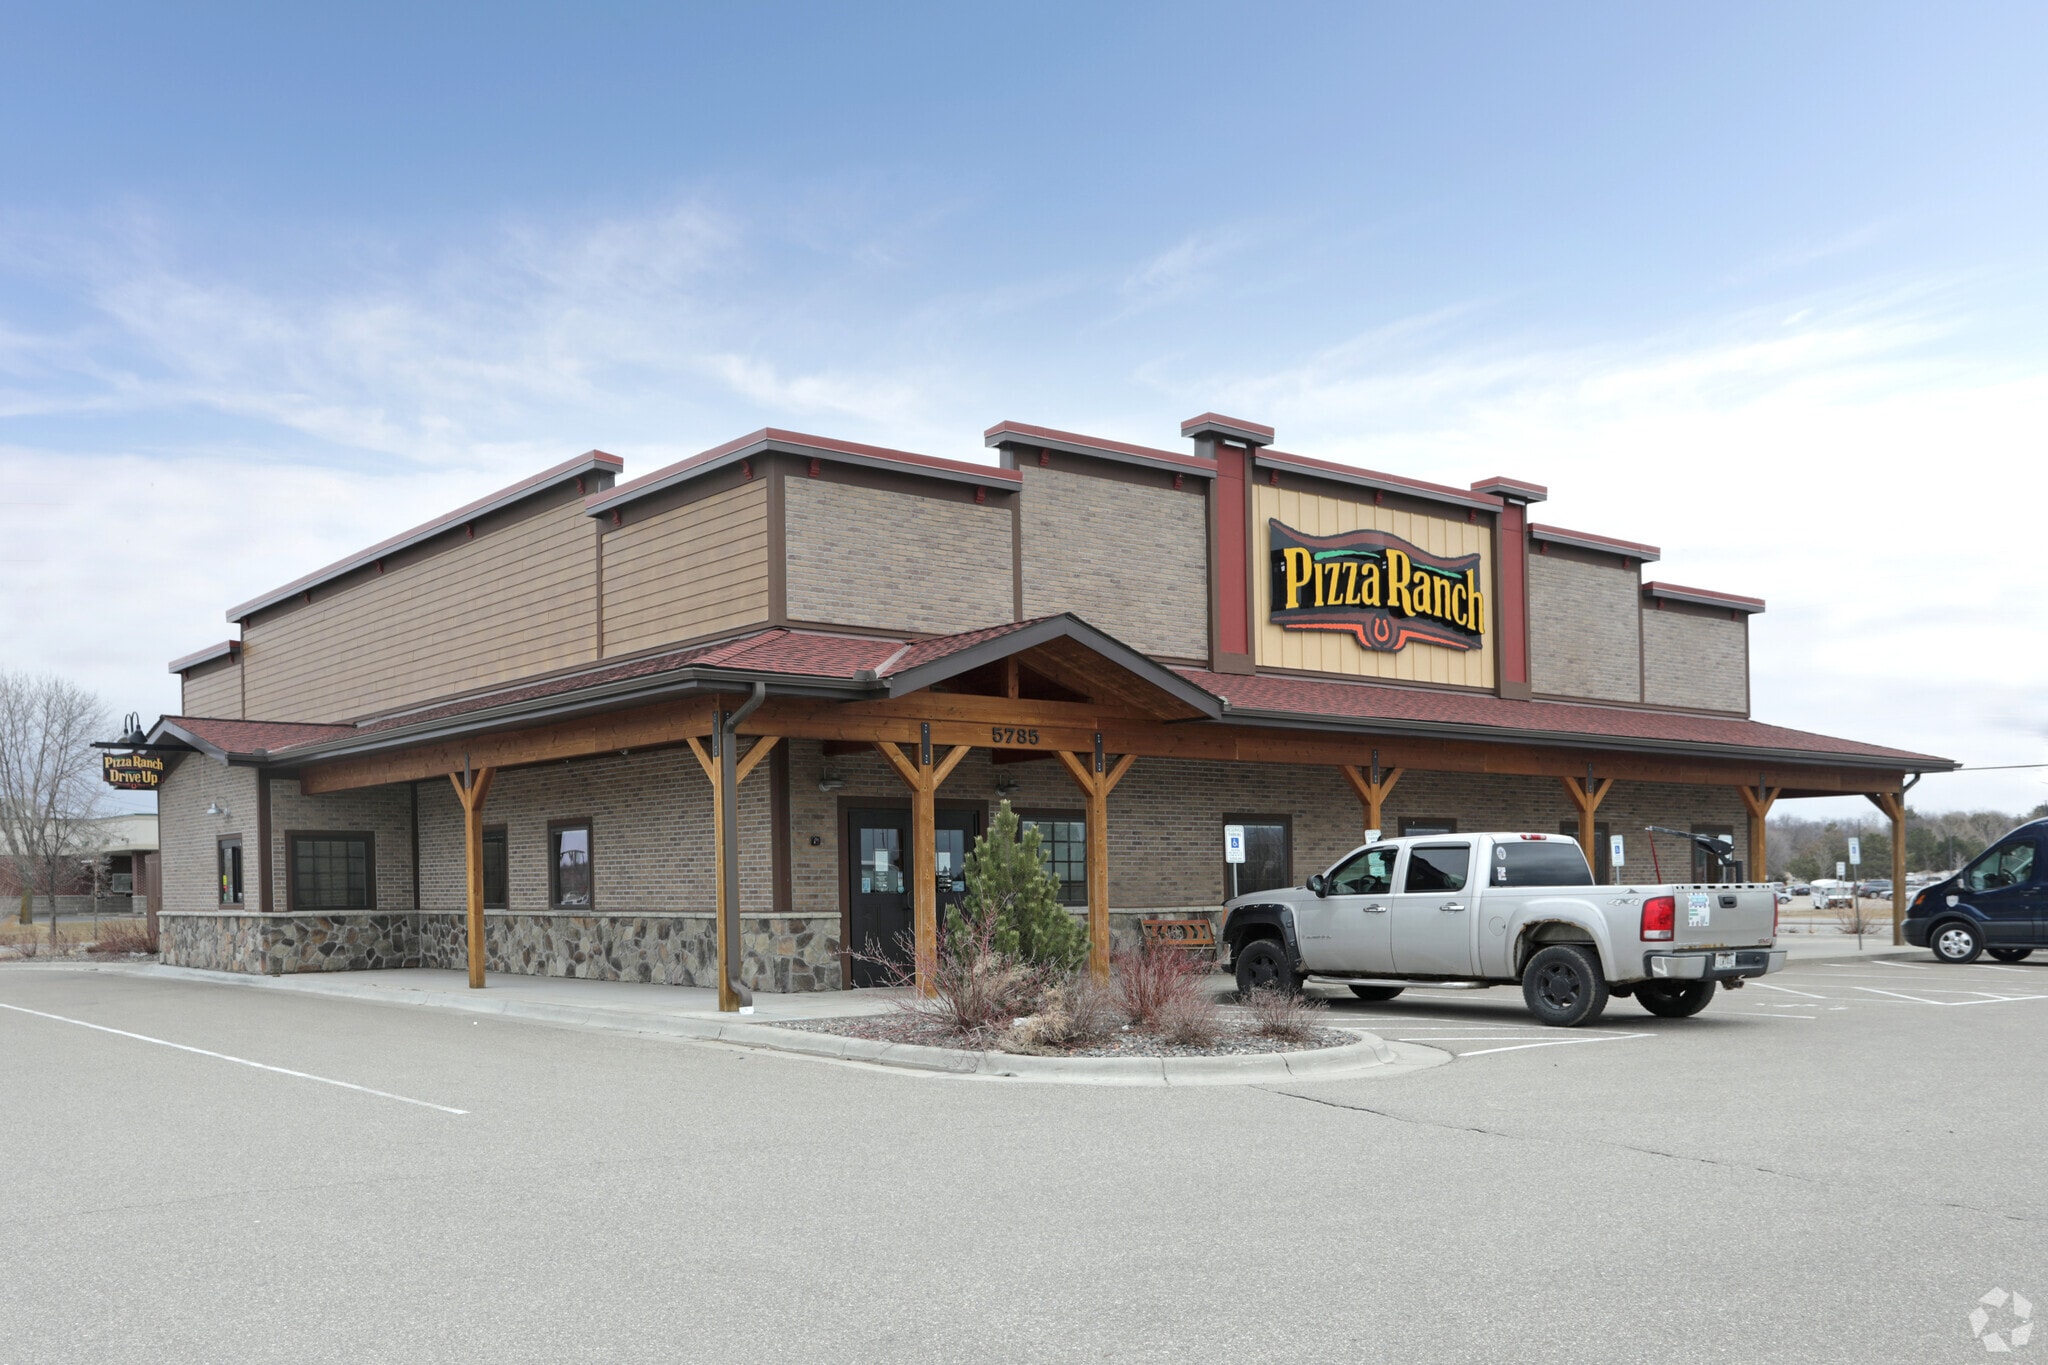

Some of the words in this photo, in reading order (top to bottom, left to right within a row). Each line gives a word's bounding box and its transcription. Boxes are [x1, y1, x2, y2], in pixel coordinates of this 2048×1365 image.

[1283, 546, 1381, 610] Pizza
[1385, 547, 1485, 634] Ranch
[991, 727, 1040, 745] 5785
[104, 756, 132, 769] Pizza
[132, 755, 163, 771] Ranch
[109, 769, 141, 783] Drive
[142, 770, 158, 786] Up
